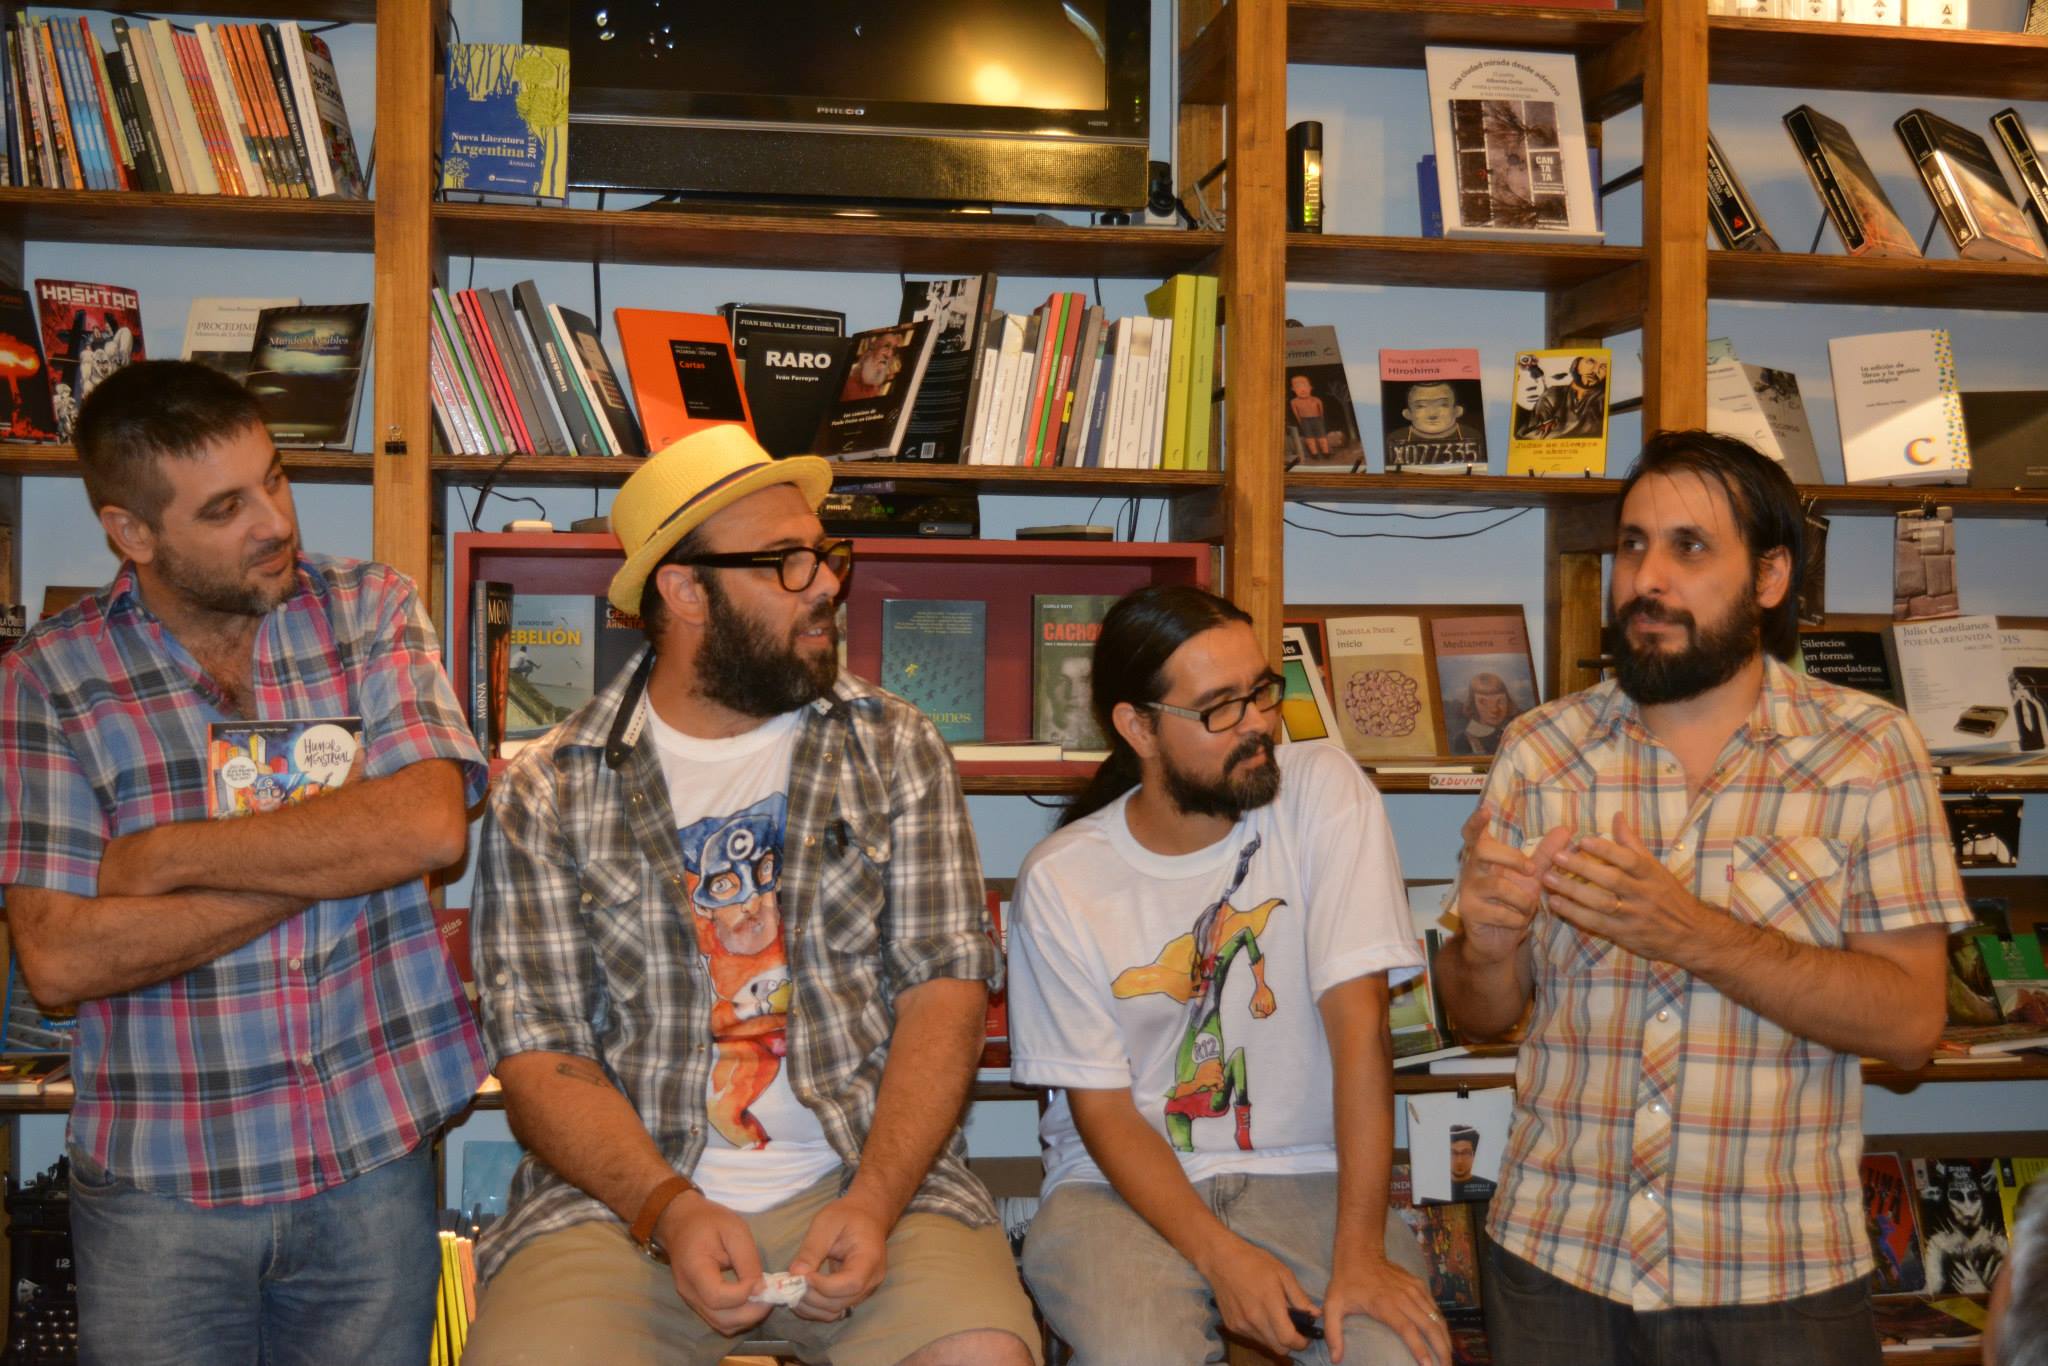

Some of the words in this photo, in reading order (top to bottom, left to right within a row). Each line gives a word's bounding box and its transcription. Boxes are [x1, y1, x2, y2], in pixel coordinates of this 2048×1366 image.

[1460, 61, 1483, 79] ciudad
[1511, 61, 1534, 74] desde
[816, 106, 865, 115] PHILCO
[452, 132, 479, 141] Nueva
[481, 134, 525, 144] Literatura
[451, 142, 525, 158] Argentina
[1536, 156, 1554, 165] CAN
[1541, 165, 1551, 173] TA
[1542, 173, 1553, 182] TA
[41, 285, 138, 311] HASHTAG
[739, 319, 759, 327] JUAN
[760, 321, 774, 329] DEL
[774, 322, 796, 330] VALLE
[679, 360, 706, 370] Cartas
[765, 350, 831, 369] RARO
[1388, 366, 1440, 376] Hiroshima
[1896, 367, 1920, 376] gestión
[1902, 625, 1928, 637] Julio
[1929, 622, 1990, 634] Castellanos
[1337, 639, 1363, 649] Inicio
[1802, 638, 1846, 649] Silencios
[1904, 636, 1939, 647] POESÍA
[1942, 632, 1992, 643] REUNIDA
[1804, 652, 1817, 661] en
[1819, 650, 1854, 662] formas
[1807, 663, 1821, 674] de
[1822, 663, 1882, 674] enredaderas
[477, 682, 488, 719] MONA
[56, 1258, 71, 1268] 12
